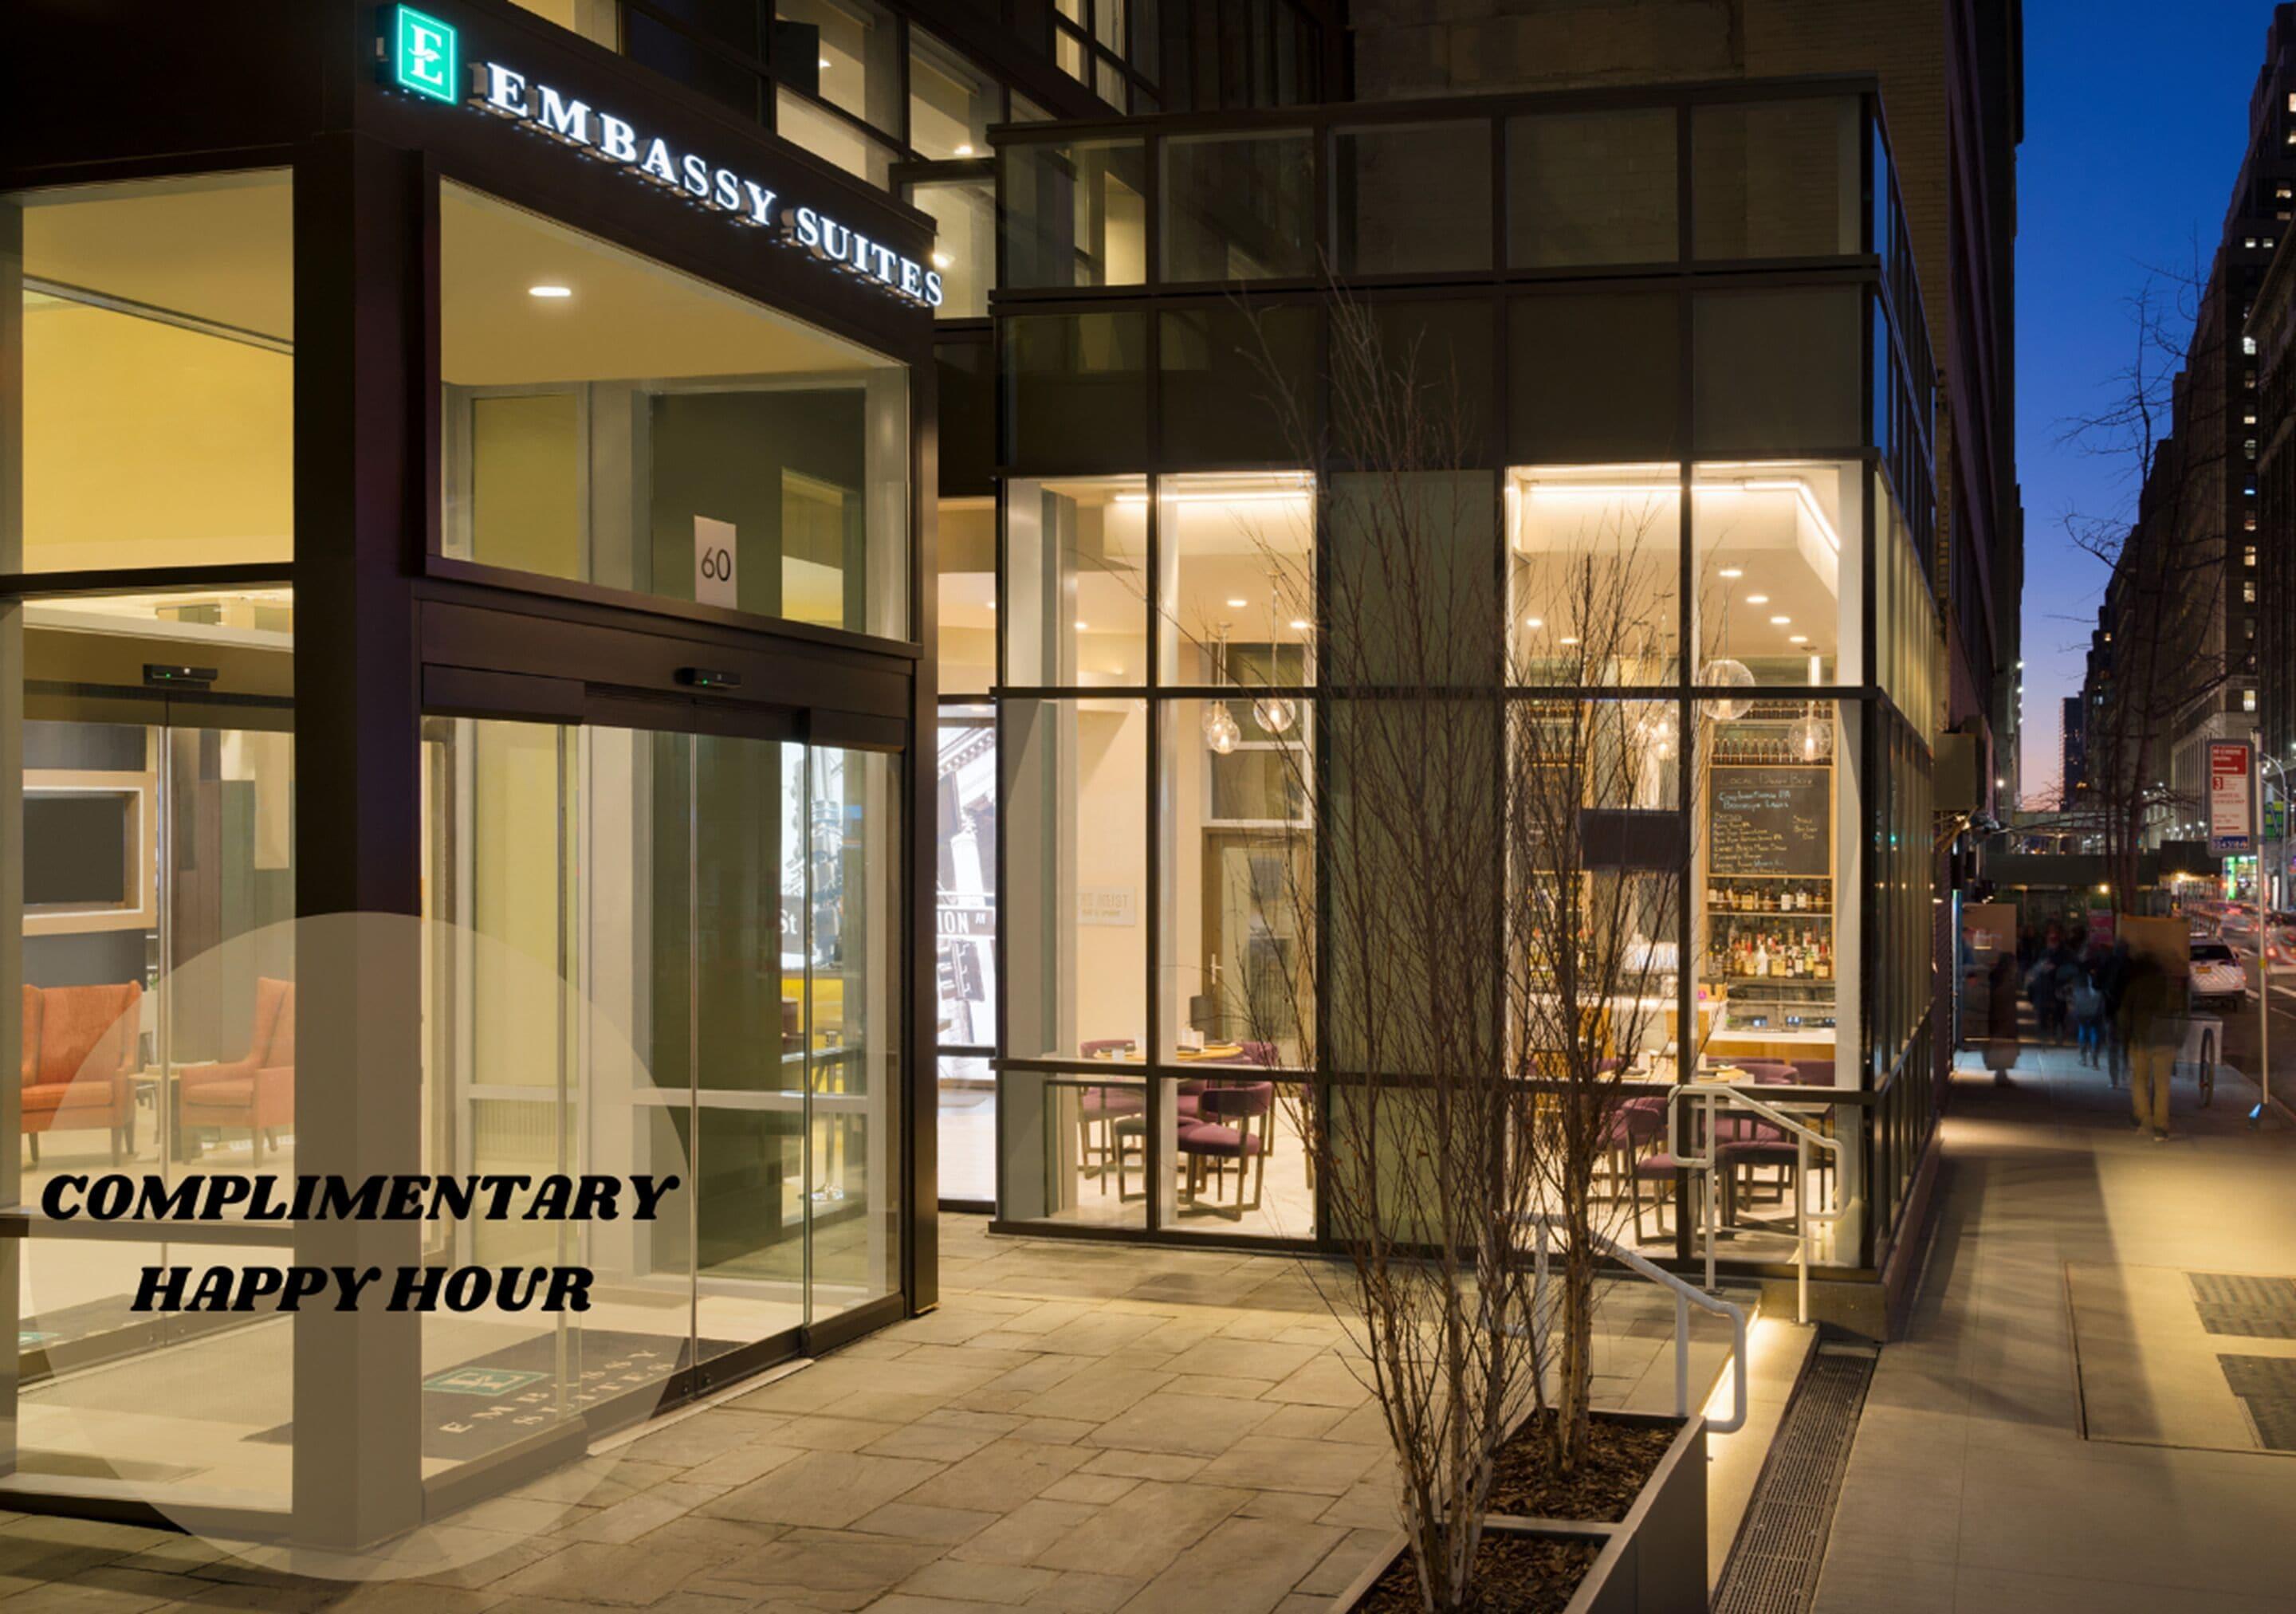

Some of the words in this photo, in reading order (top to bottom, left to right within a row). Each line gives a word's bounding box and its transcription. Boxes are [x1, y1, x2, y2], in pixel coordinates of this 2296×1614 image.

[408, 23, 442, 86] E
[486, 61, 778, 226] EMBASSY
[796, 206, 944, 307] SUITES
[701, 546, 731, 583] 60
[439, 1349, 661, 1433] EMBASSY
